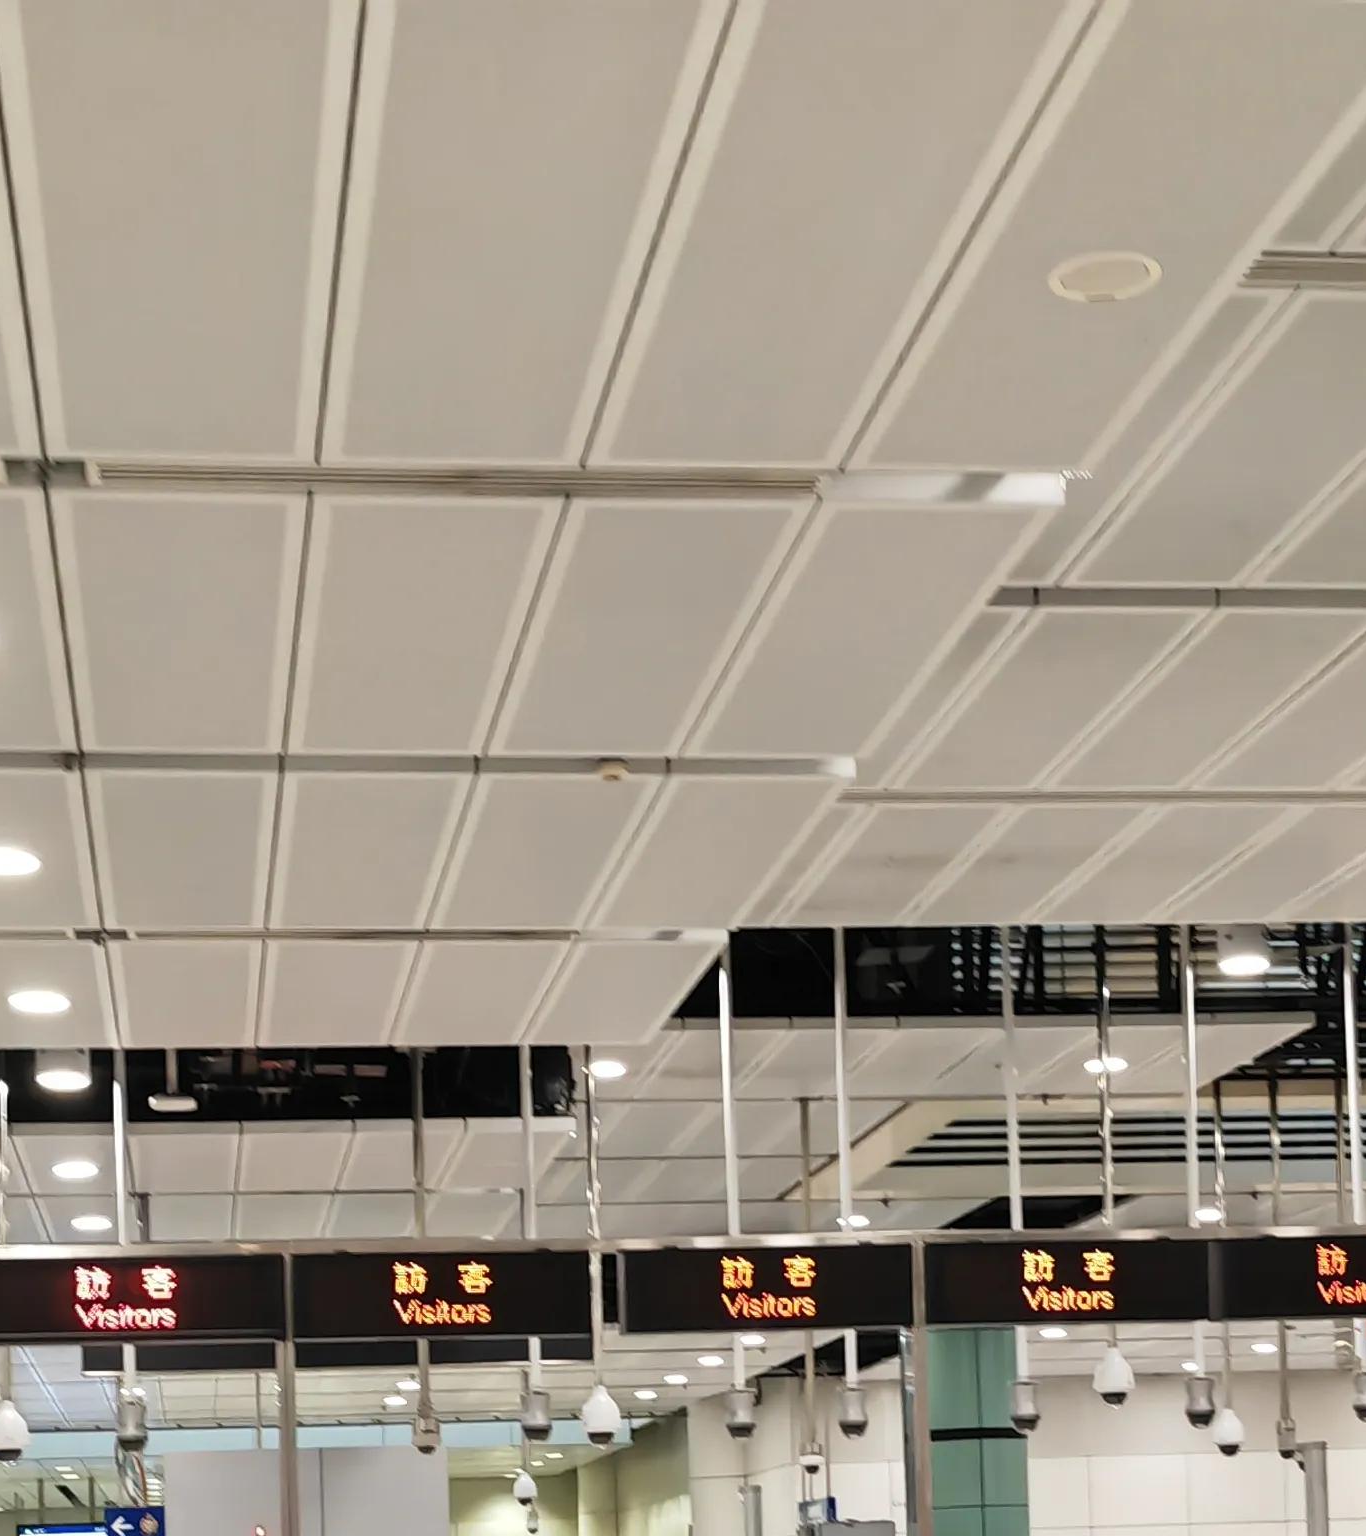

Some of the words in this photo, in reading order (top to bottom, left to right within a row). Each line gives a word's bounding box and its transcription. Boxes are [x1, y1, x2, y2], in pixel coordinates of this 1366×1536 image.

[392, 1261, 493, 1295] 訪客
[721, 1255, 817, 1289] 訪客
[1022, 1249, 1115, 1283] 訪客
[74, 1267, 178, 1301] 訪客
[1022, 1286, 1115, 1312] Visitors
[74, 1303, 177, 1330] Visitors
[394, 1299, 492, 1325] Visitors
[721, 1292, 817, 1319] Visitors
